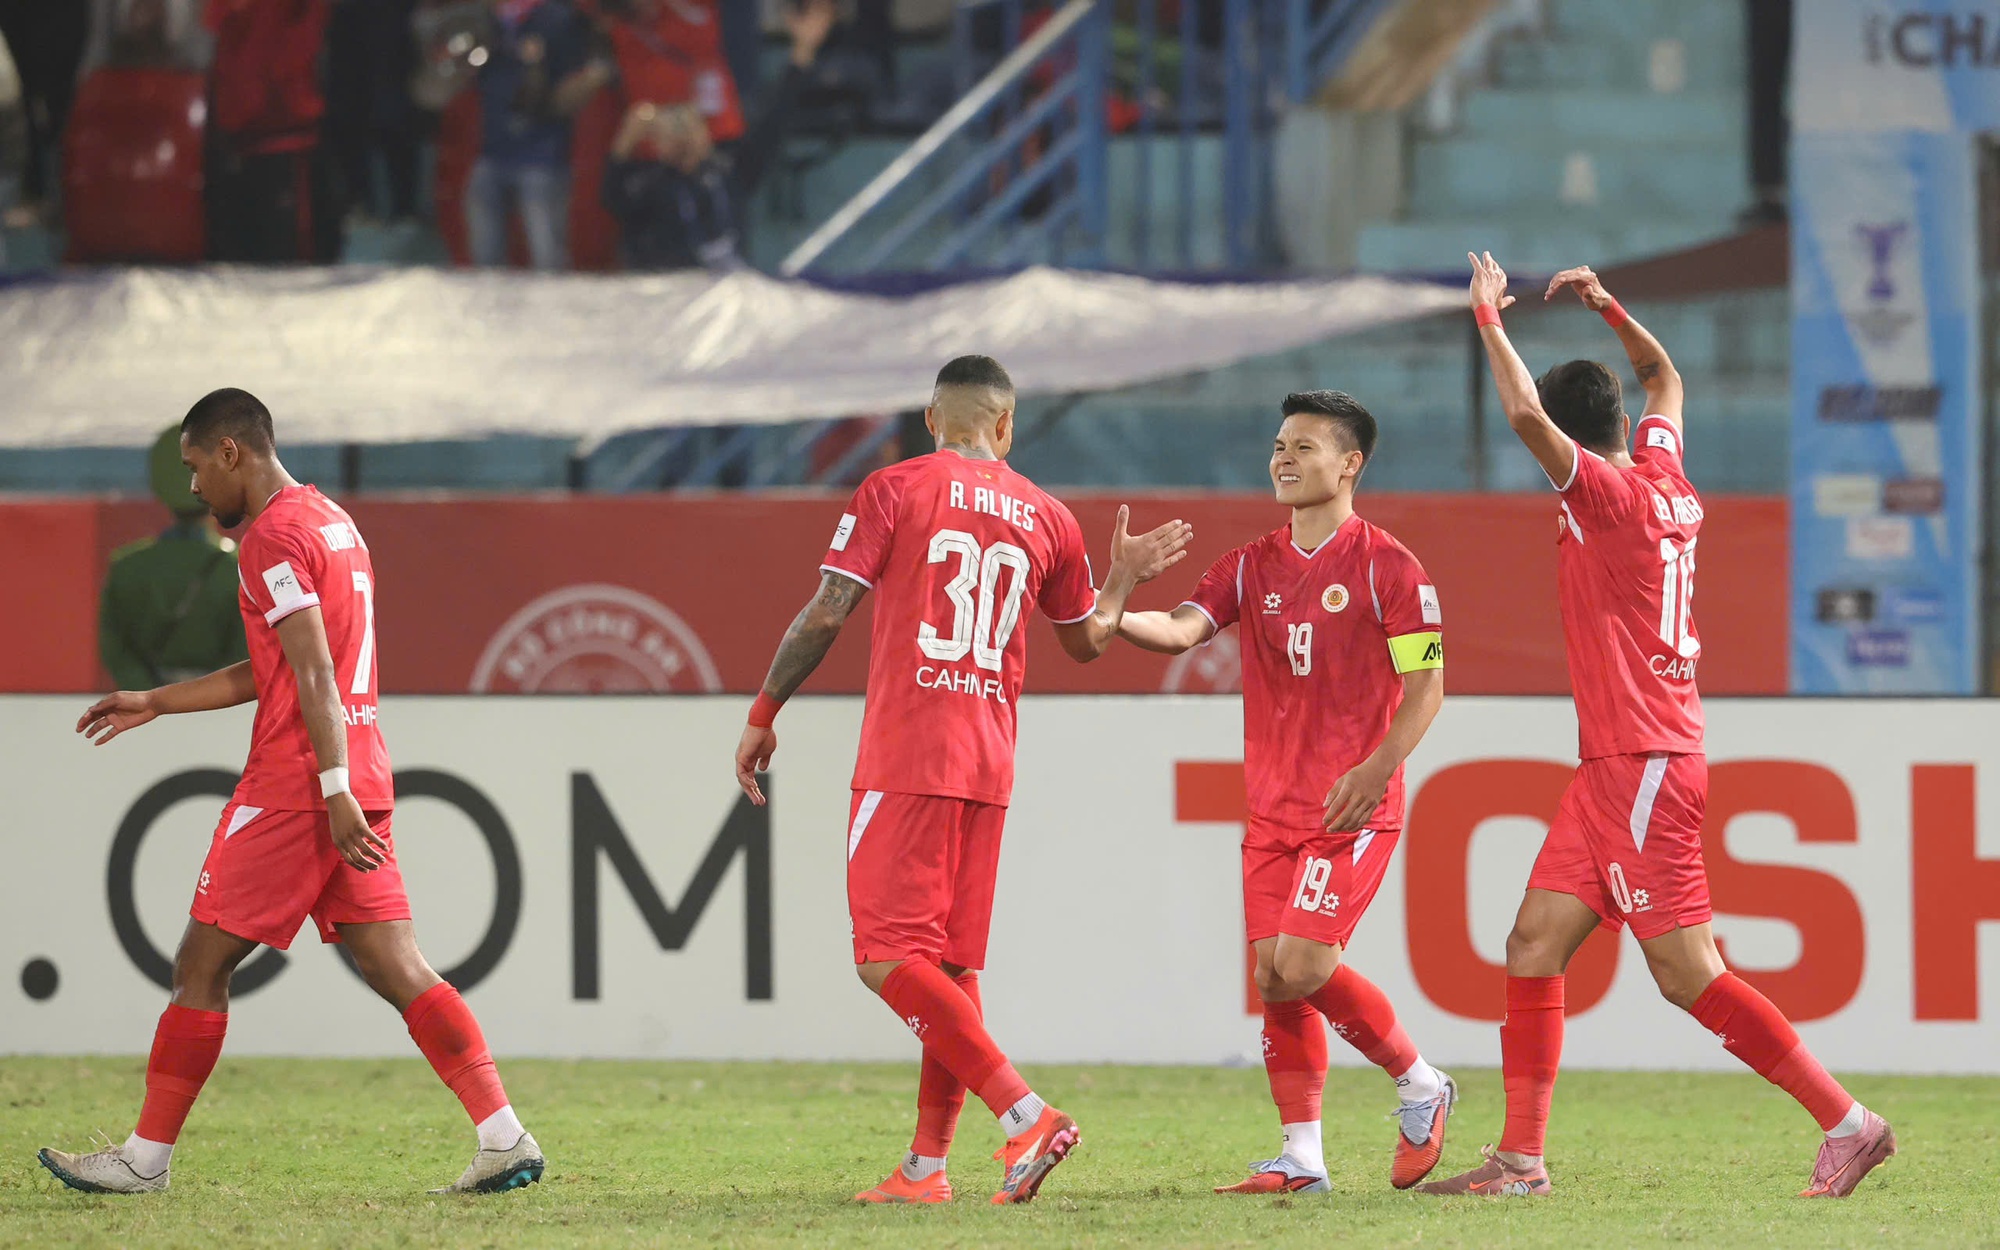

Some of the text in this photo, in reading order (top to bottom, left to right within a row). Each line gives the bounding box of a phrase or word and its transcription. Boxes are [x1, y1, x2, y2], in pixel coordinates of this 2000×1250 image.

[950, 481, 1036, 532] R. ALVES
[273, 575, 293, 592] AFC
[917, 528, 1030, 672] 30
[351, 571, 375, 694] 7
[1287, 622, 1314, 676] 19
[1421, 641, 1442, 662] AF
[1293, 856, 1333, 912] 19
[1608, 862, 1633, 914] 0
